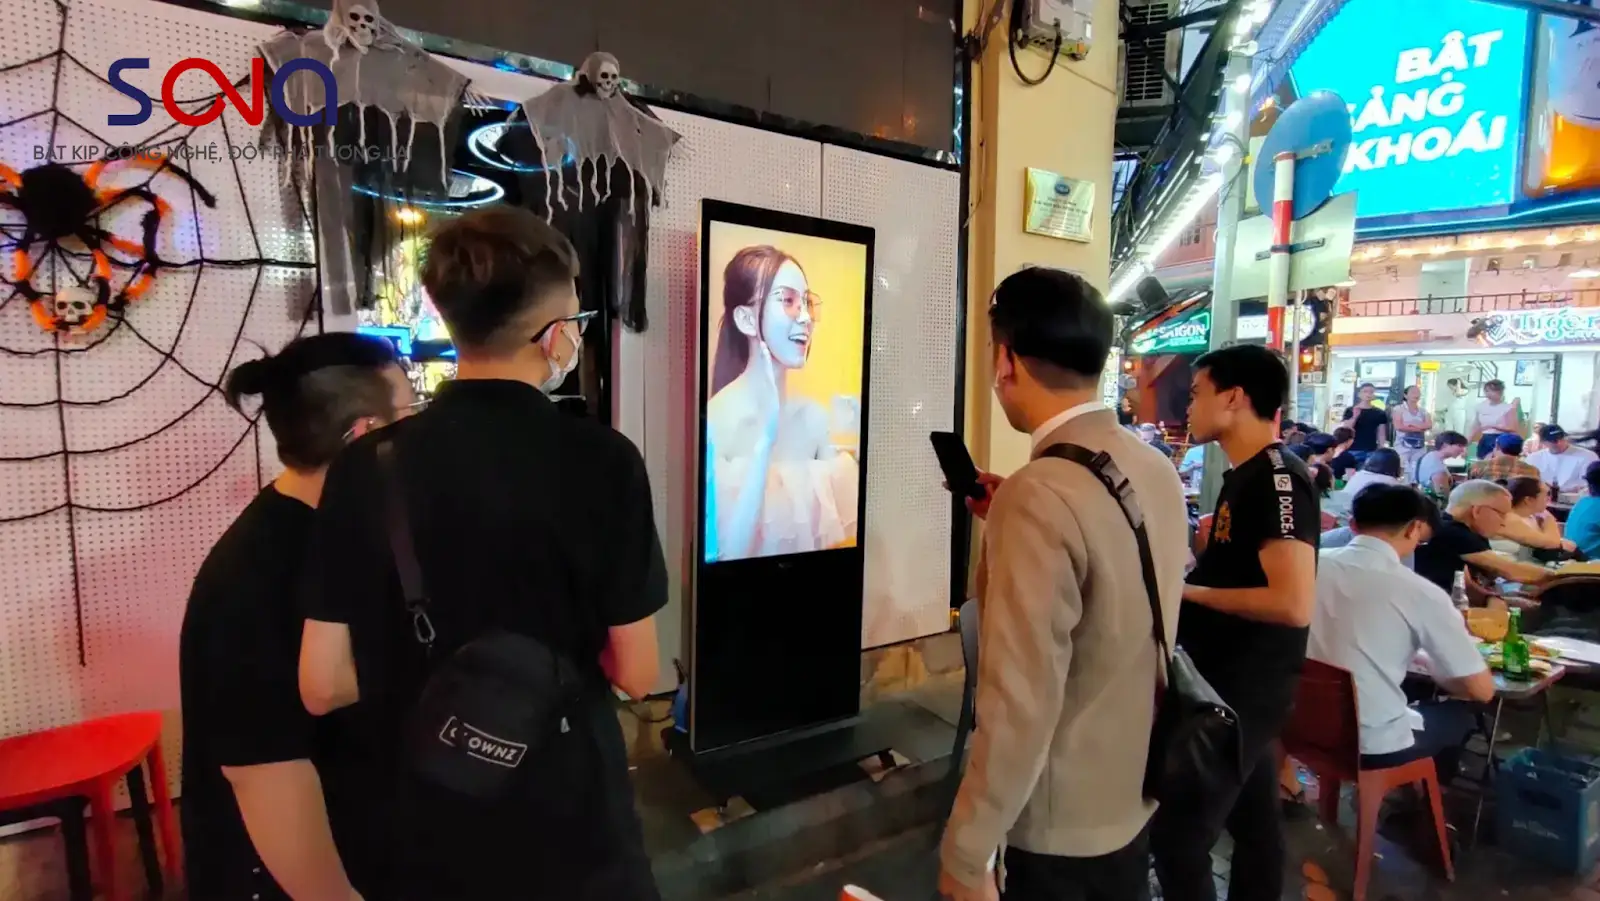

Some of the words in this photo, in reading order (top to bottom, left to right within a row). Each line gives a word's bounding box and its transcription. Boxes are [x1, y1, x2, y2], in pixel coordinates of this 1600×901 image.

[1395, 29, 1504, 84] BẬT
[1347, 81, 1467, 133] ẢNG
[1342, 110, 1508, 174] KHOÁI
